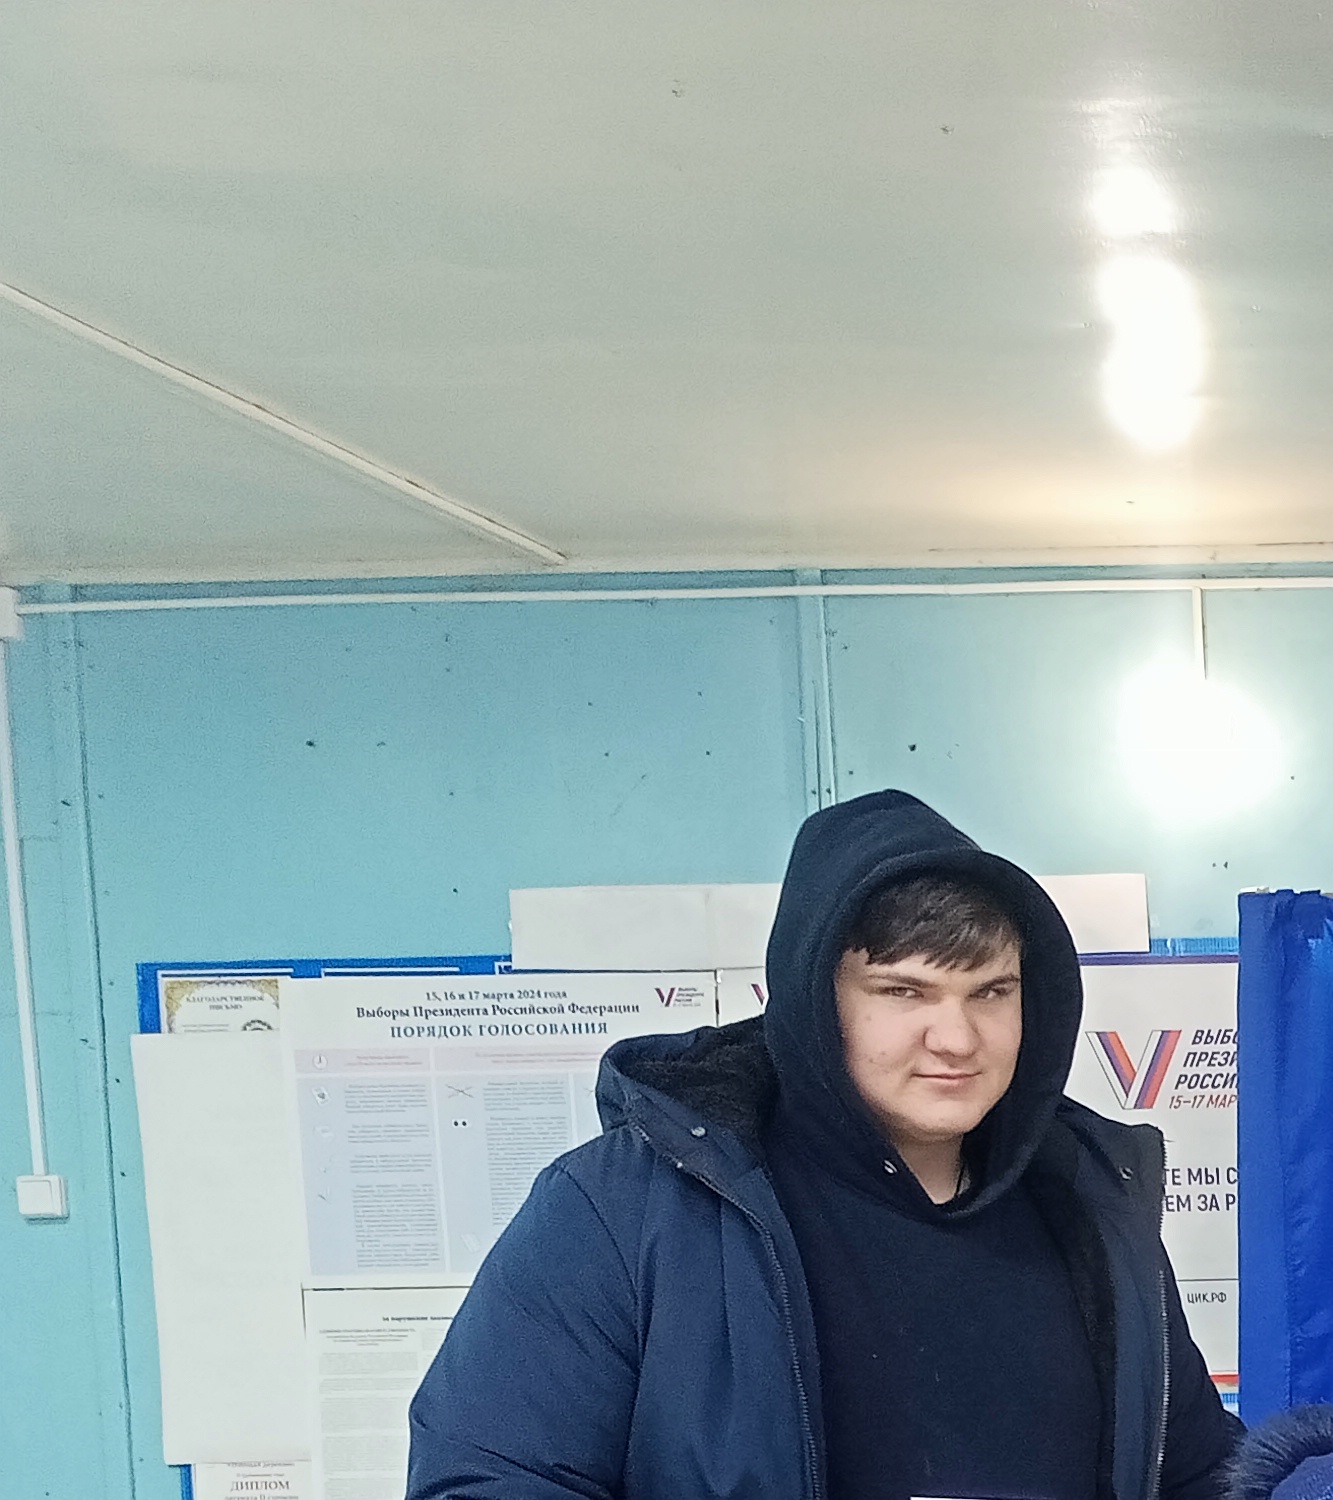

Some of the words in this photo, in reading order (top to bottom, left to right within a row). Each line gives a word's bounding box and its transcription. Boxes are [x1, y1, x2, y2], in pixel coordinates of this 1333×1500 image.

[444, 991, 456, 1000] 16
[468, 991, 480, 1000] 17
[483, 992, 514, 1002] марта
[517, 990, 541, 999] 2024
[544, 991, 567, 1000] года
[356, 1006, 409, 1020] Выборы
[413, 1005, 489, 1020] Президента
[491, 1003, 565, 1016] Российской
[567, 1002, 640, 1016] Федерации
[390, 1025, 473, 1039] ПОРЯДОК
[478, 1022, 608, 1037] ГОЛОСОВАНИЯ
[1174, 1072, 1238, 1090] РОССИ
[1187, 1167, 1220, 1186] МЫ
[1197, 1194, 1220, 1212] ЗА
[1225, 1193, 1236, 1211] Р
[1187, 1292, 1227, 1304] ЦИК.РФ
[230, 1480, 290, 1491] ДИПЛОМ
